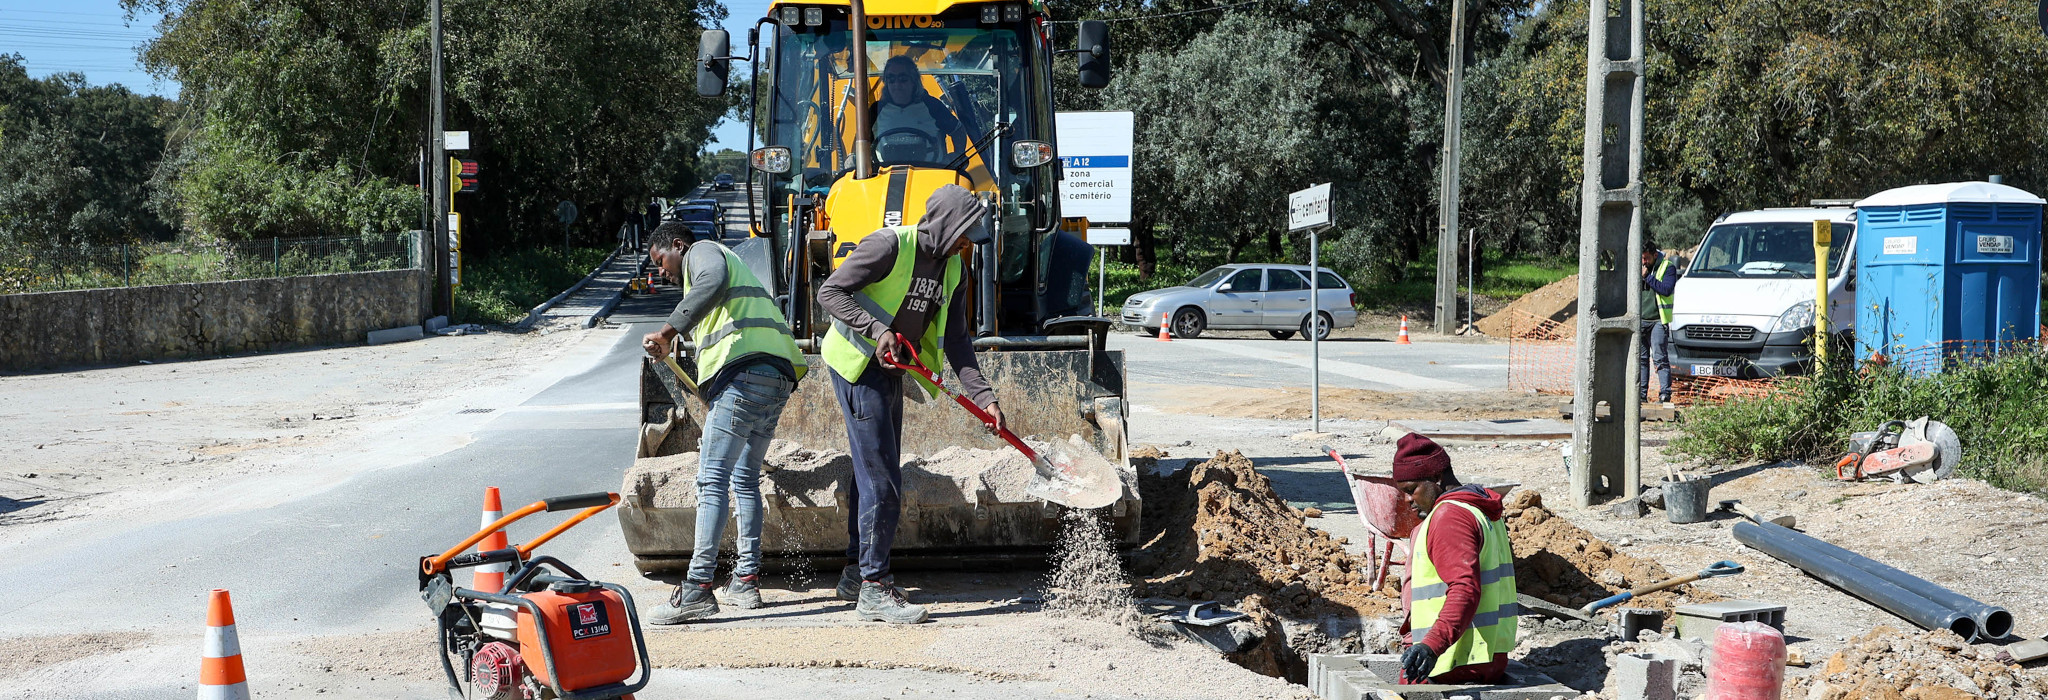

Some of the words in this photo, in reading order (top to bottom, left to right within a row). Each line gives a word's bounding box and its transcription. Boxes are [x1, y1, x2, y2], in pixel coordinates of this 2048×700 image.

[848, 14, 933, 29] OTIVO
[1070, 180, 1114, 188] comercial
[907, 298, 930, 312] 199
[1700, 315, 1738, 323] IVECO
[1699, 366, 1712, 375] BC
[573, 628, 589, 637] PCX
[590, 624, 609, 634] 13/40
